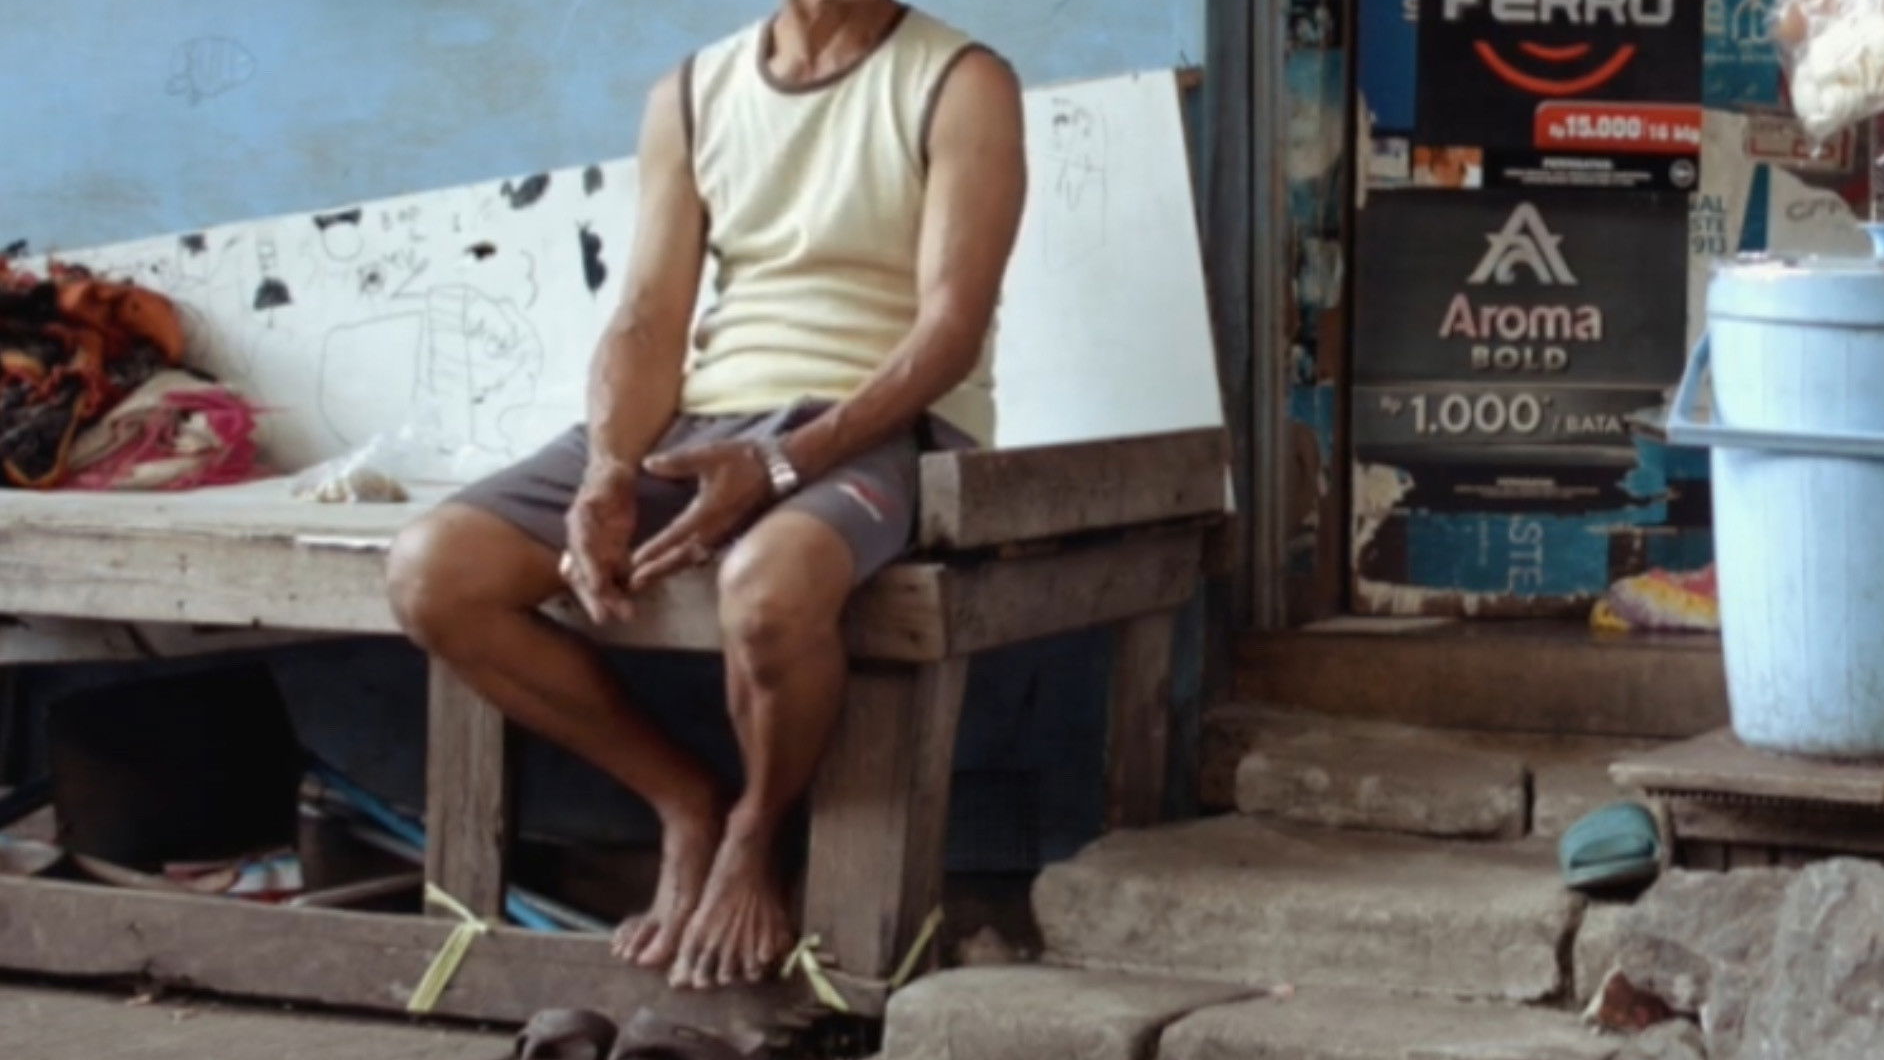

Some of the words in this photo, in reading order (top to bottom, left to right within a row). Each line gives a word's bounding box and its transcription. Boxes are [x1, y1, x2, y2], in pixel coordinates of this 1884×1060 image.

[1564, 113, 1641, 139] 15.000
[1438, 293, 1602, 340] Aroma
[1471, 347, 1568, 370] BOLD
[1410, 393, 1541, 433] 1.000
